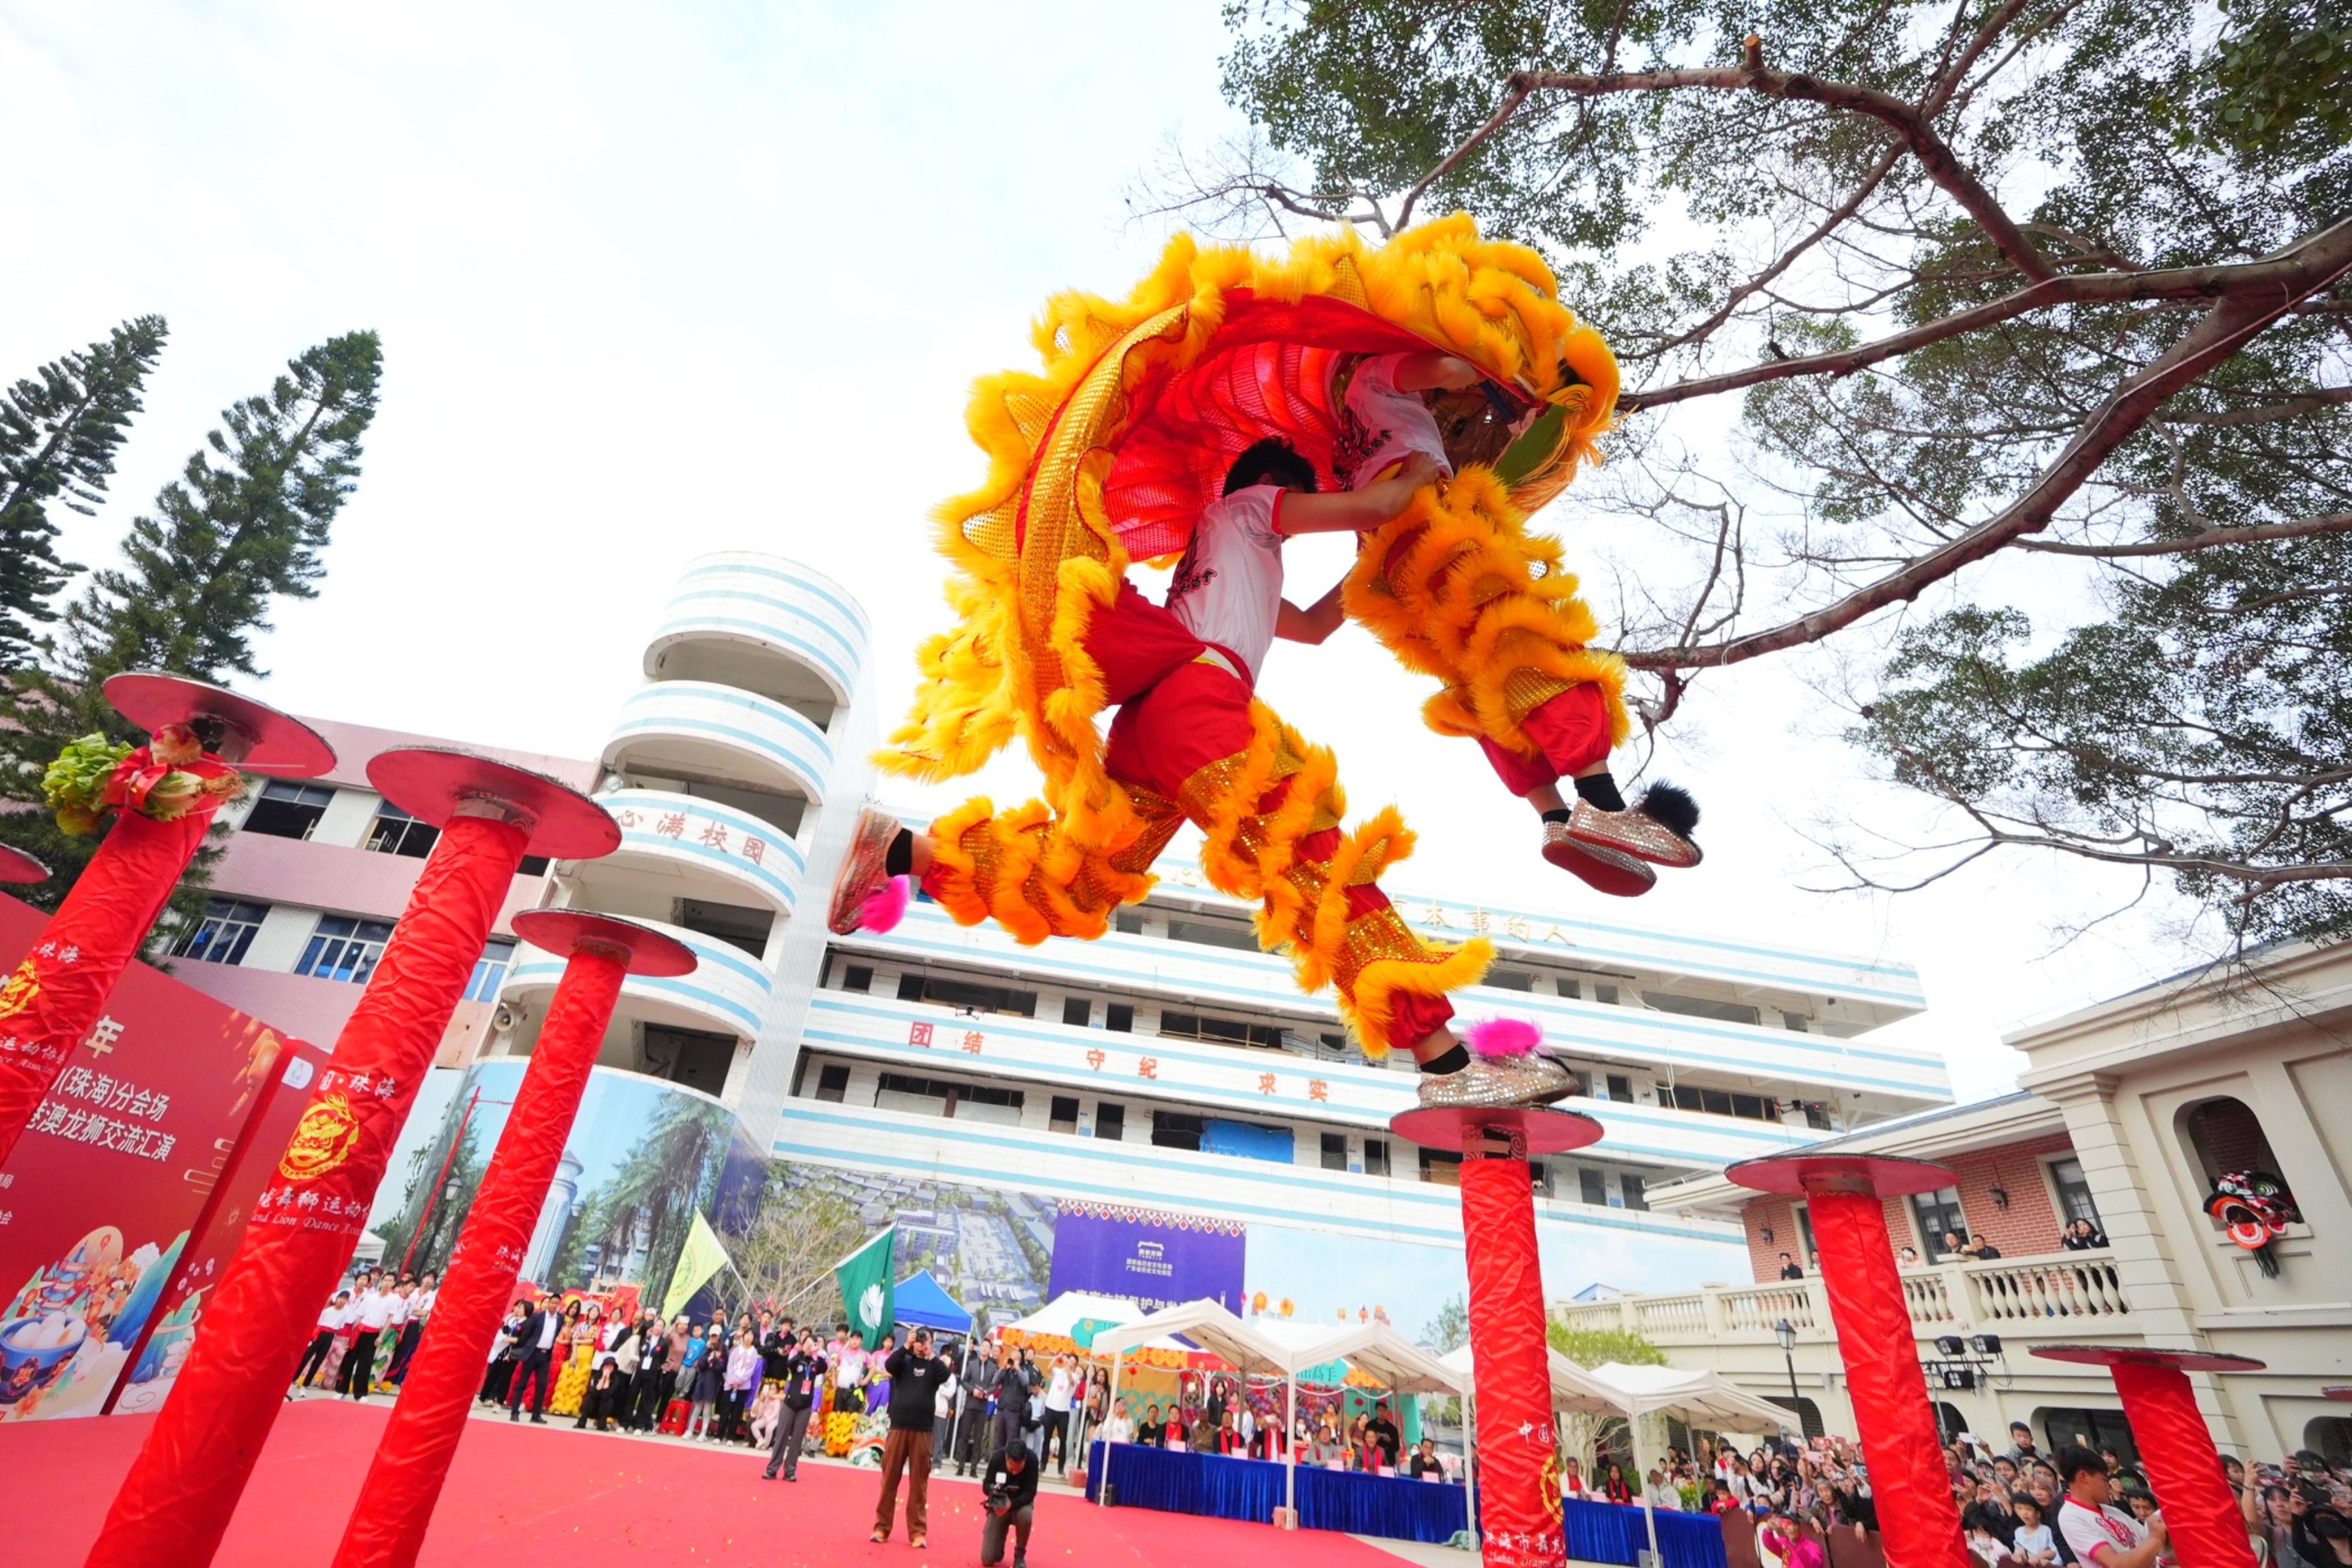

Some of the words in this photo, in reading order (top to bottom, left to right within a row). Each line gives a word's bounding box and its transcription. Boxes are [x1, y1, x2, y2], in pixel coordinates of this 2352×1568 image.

[616, 810, 766, 865] 心满校园
[85, 1015, 125, 1059] 年
[910, 1022, 984, 1055] 团结
[1086, 1048, 1158, 1080] 守纪
[1259, 1072, 1328, 1103] 求实
[50, 1066, 170, 1122] (珠海)分会场
[271, 1212, 298, 1226] Lion
[303, 1216, 339, 1232] Dance
